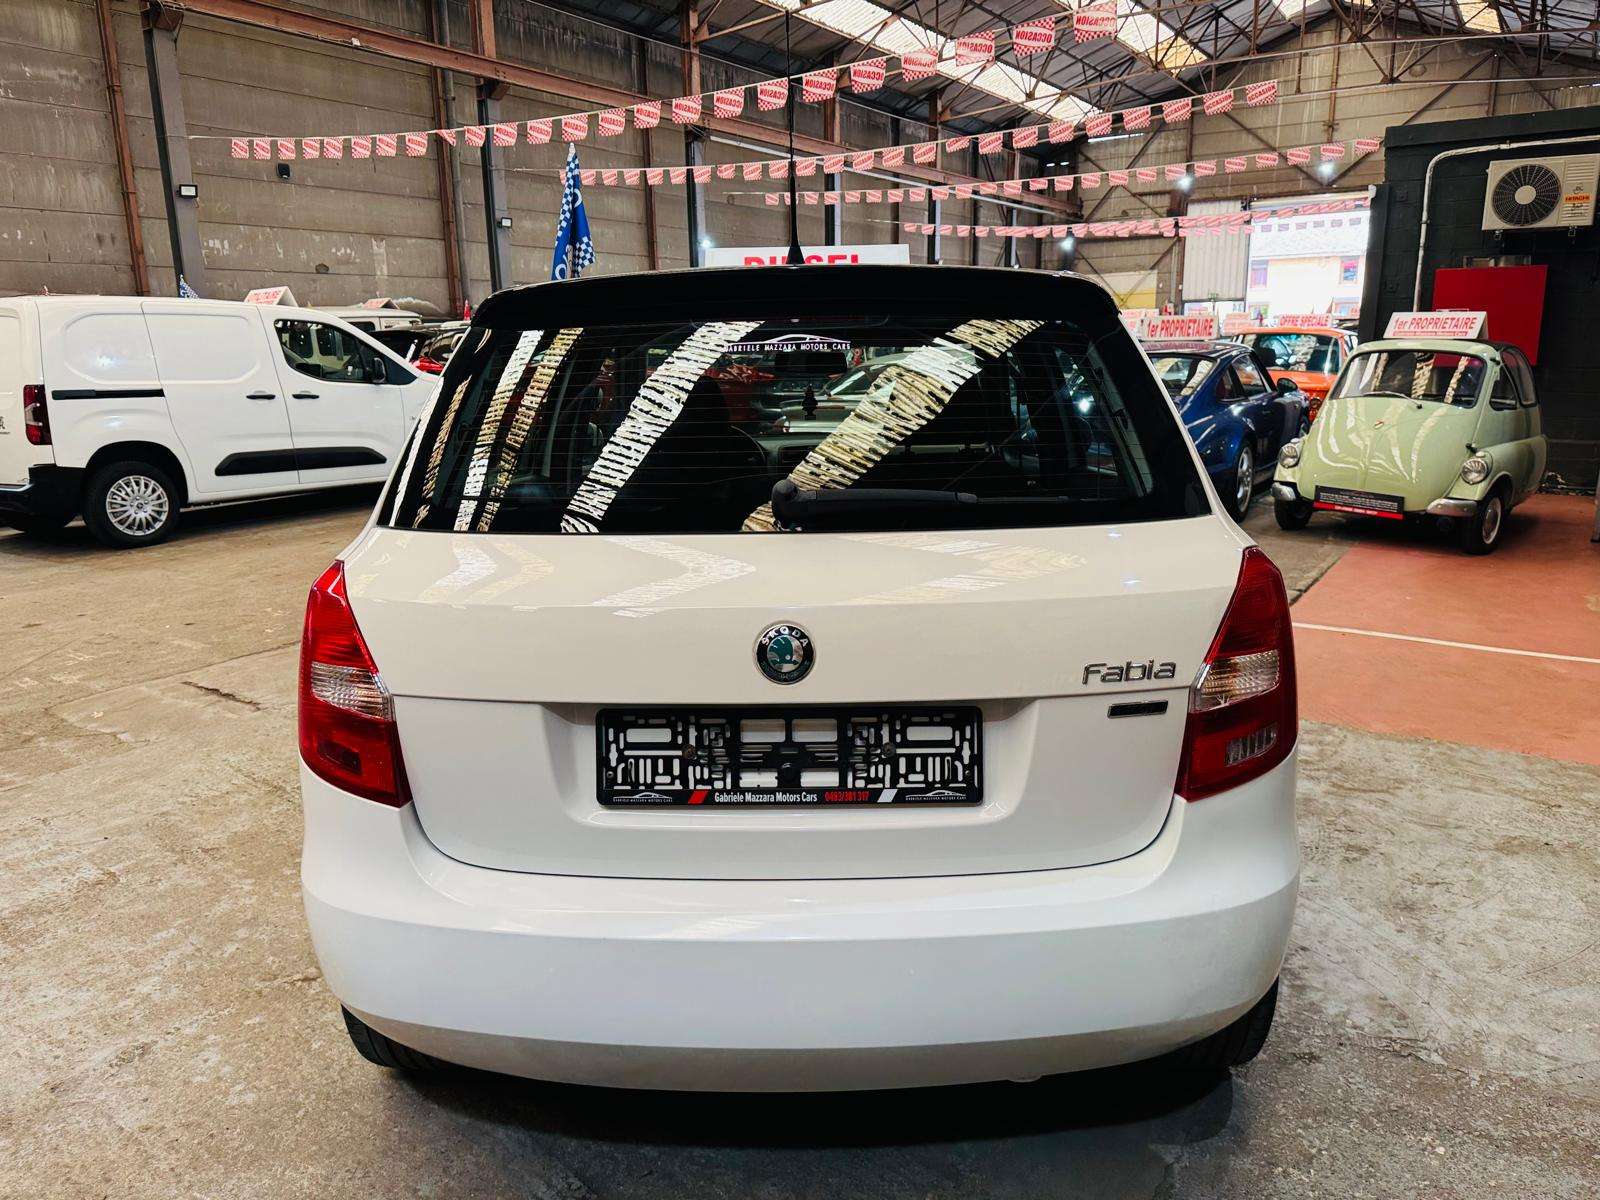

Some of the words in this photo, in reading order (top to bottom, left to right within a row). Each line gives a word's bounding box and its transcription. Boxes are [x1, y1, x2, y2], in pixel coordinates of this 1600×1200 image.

[1204, 94, 1233, 111] OCCASION
[800, 343, 828, 351] MOTORS
[1082, 658, 1177, 685] Fabia
[714, 791, 744, 803] Gabriele
[745, 792, 775, 802] Mazzara
[776, 792, 800, 802] Motors
[801, 791, 818, 802] Cars
